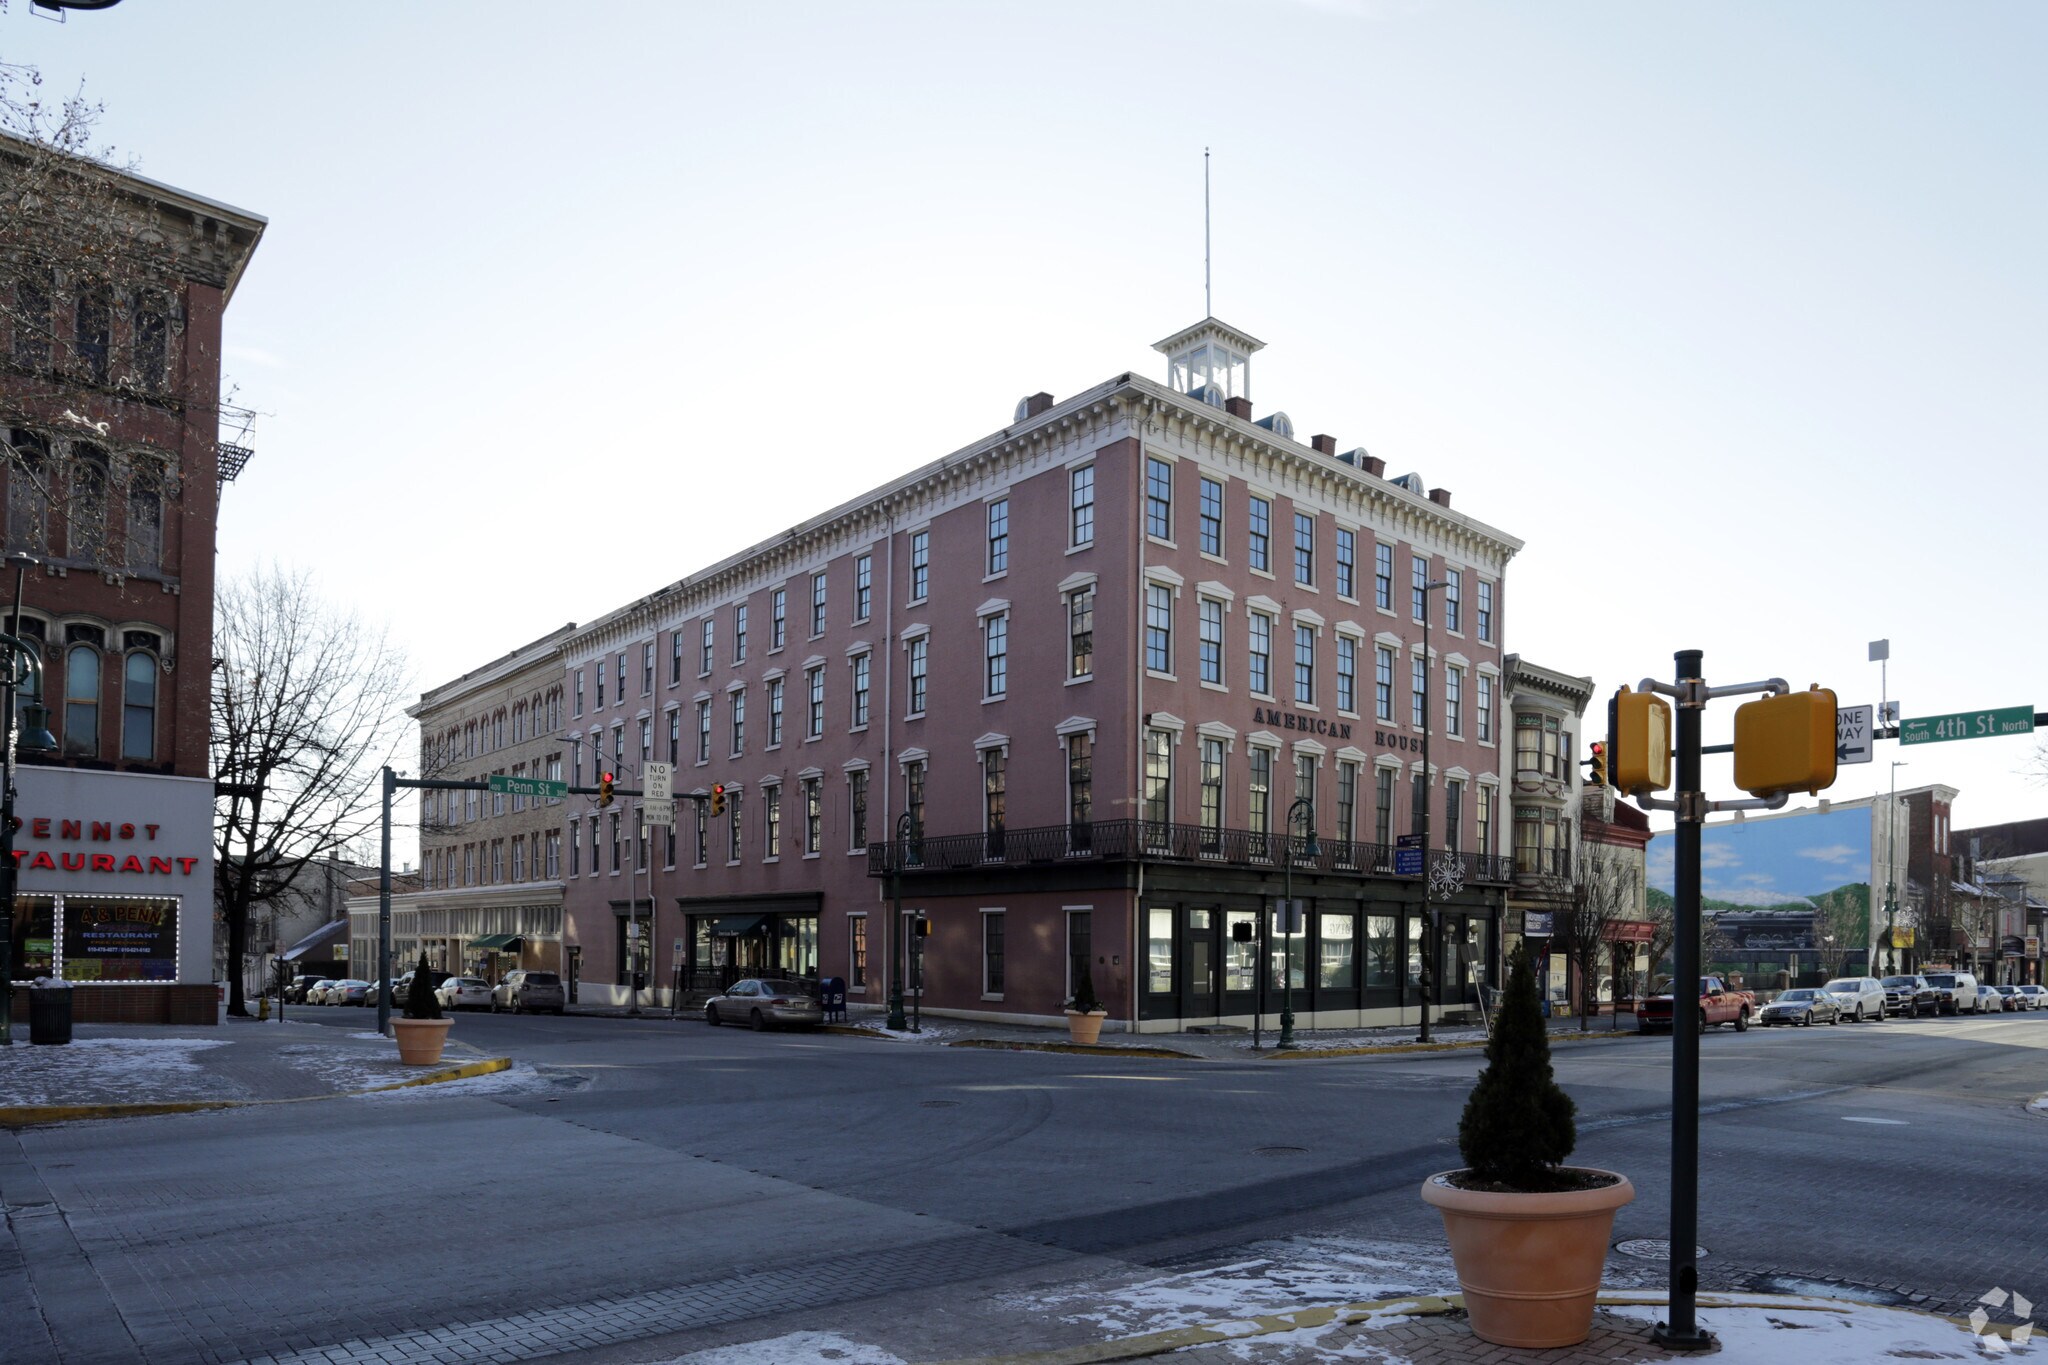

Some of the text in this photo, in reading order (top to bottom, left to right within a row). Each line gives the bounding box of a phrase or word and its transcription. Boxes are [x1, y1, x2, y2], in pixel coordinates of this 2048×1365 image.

[1253, 707, 1352, 740] AMERICAN
[1935, 714, 1995, 738] 4th St
[2002, 719, 2029, 732] North
[1904, 730, 1930, 742] South
[650, 765, 666, 774] NO
[507, 780, 550, 795] Penn St
[97, 906, 109, 922] &
[115, 905, 161, 925] PENN
